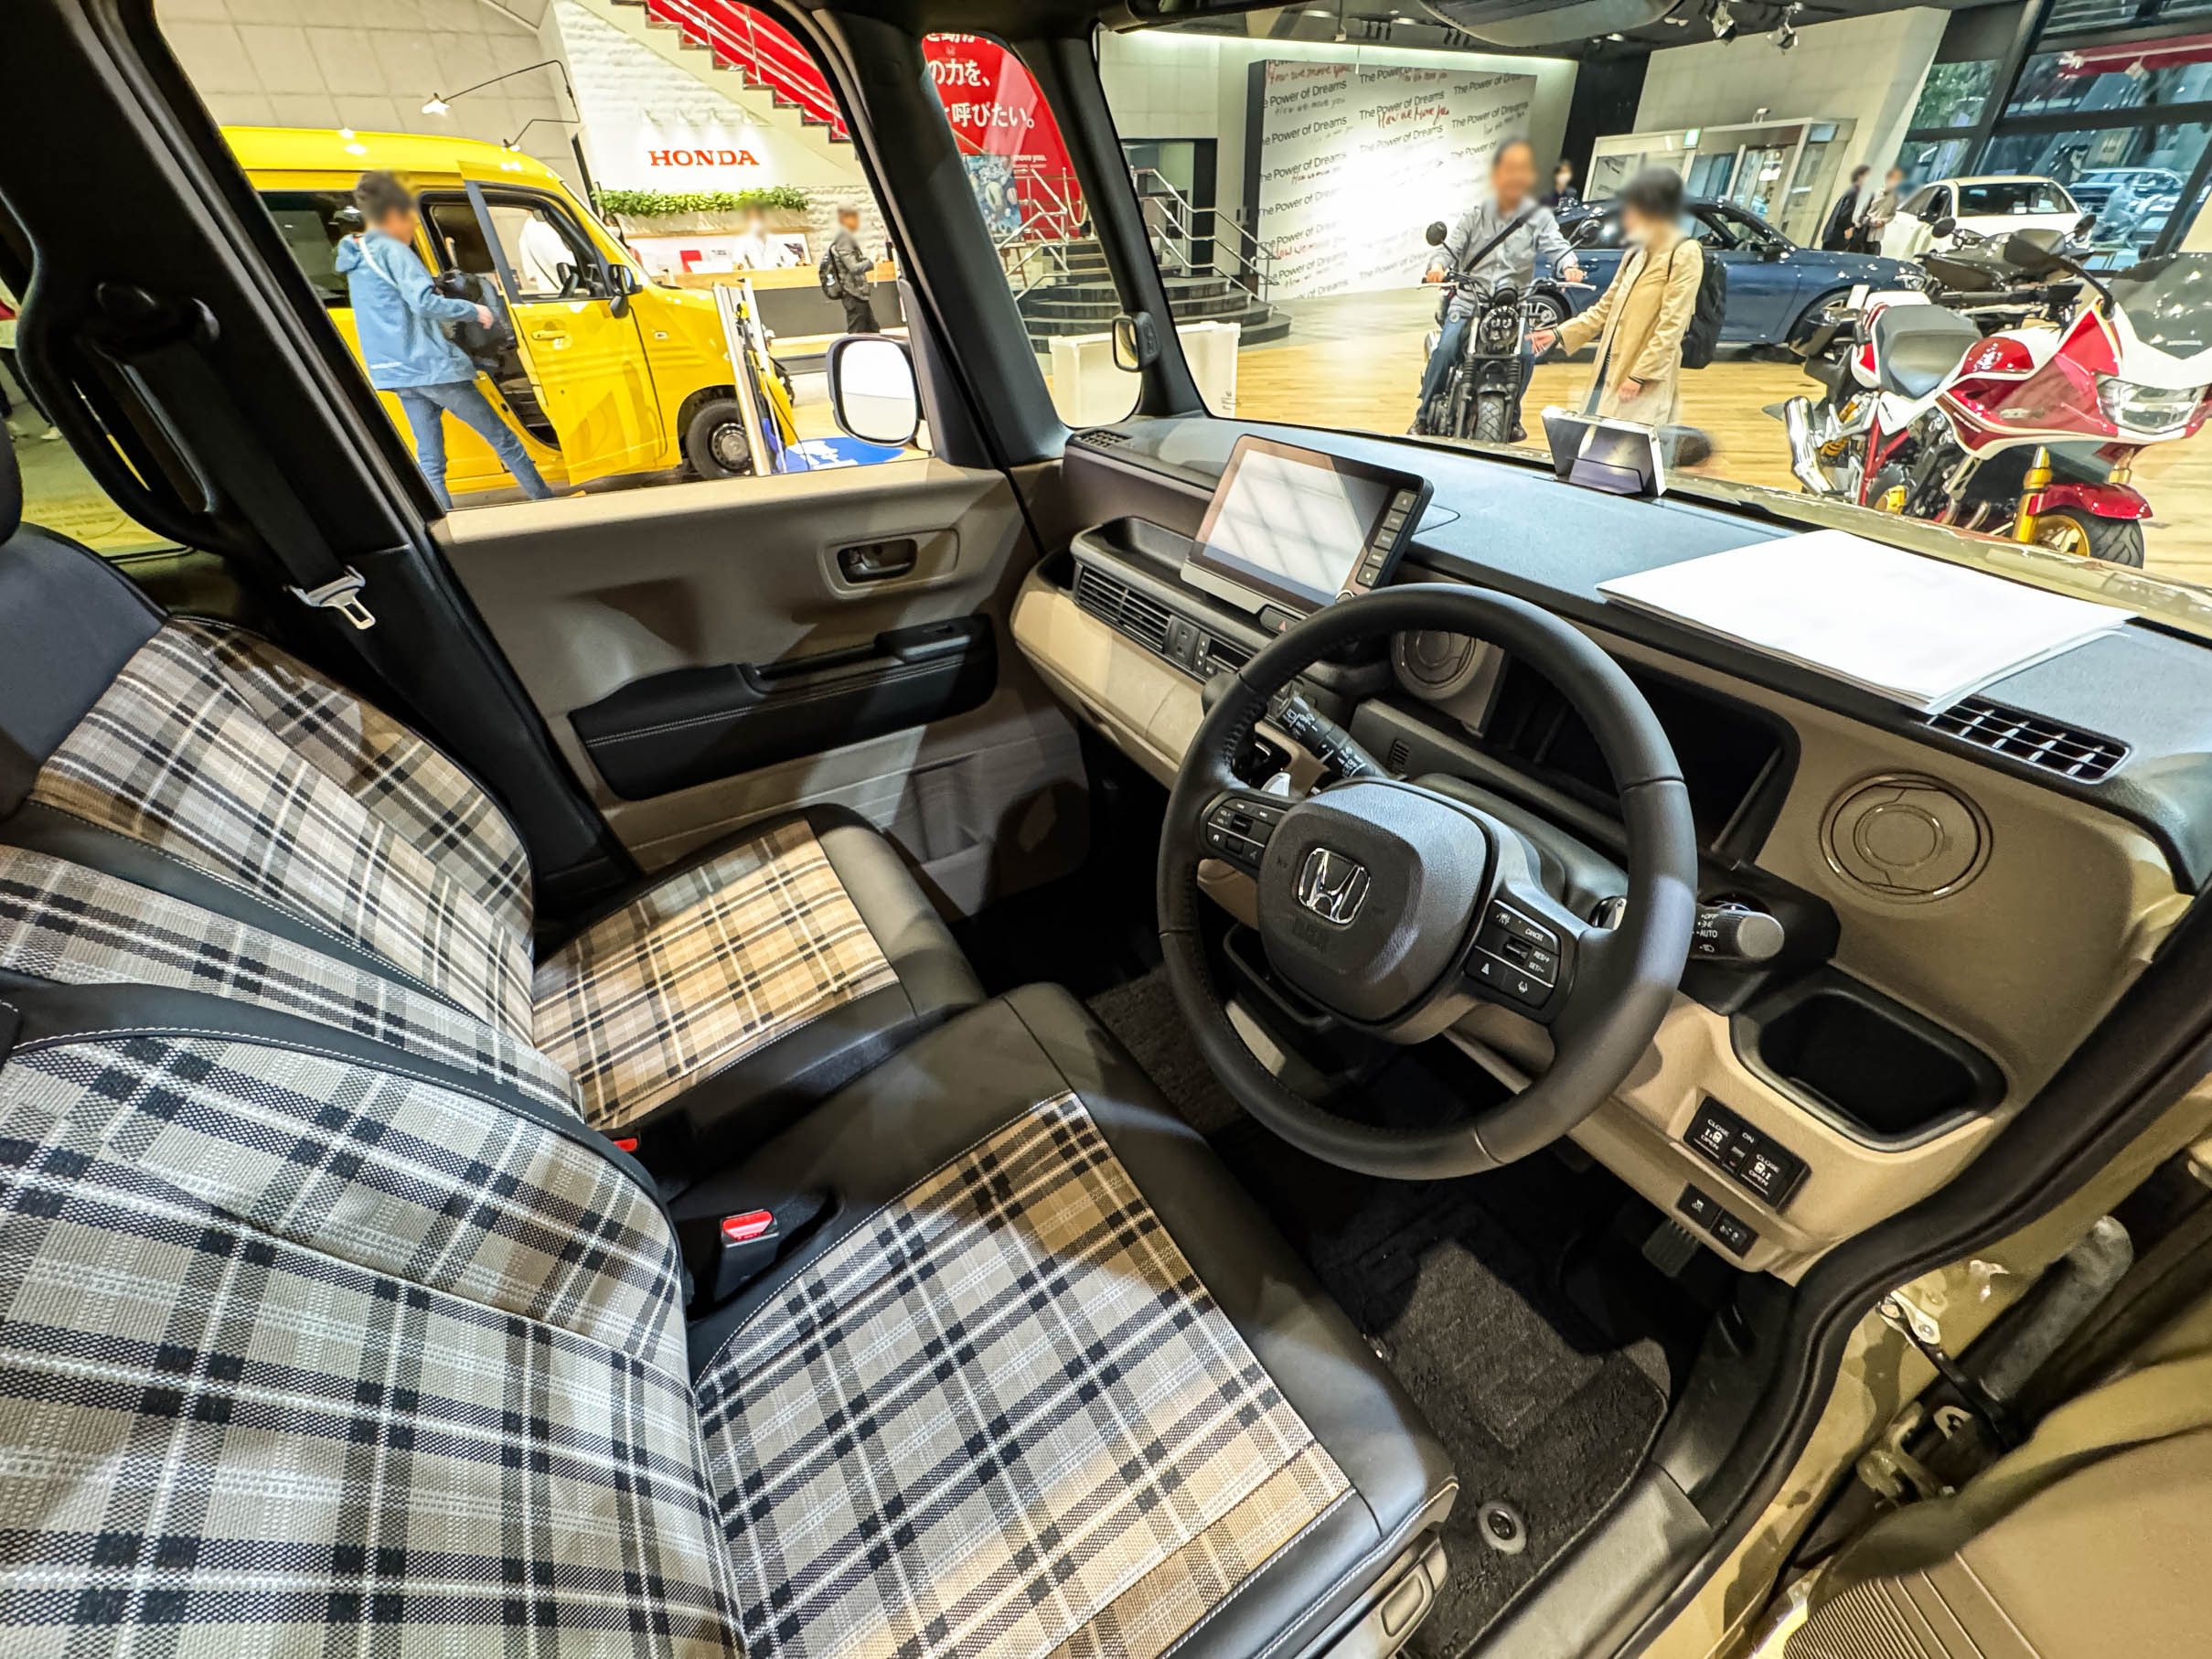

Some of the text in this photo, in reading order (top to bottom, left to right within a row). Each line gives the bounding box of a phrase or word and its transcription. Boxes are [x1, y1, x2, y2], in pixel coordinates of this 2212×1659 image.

[1359, 73, 1375, 85] The
[1453, 85, 1468, 95] The
[1469, 80, 1493, 91] Power
[1493, 76, 1502, 86] of
[1270, 91, 1298, 106] Power
[1299, 87, 1309, 100] of
[1311, 80, 1347, 96] Dreams
[945, 102, 1035, 129] 呼びたい。
[1359, 91, 1445, 121] The Power of Dreams
[1451, 119, 1467, 129] The
[1467, 112, 1491, 125] Power
[1491, 107, 1501, 118] of
[1271, 128, 1301, 144] Power
[1301, 123, 1311, 136] of
[1313, 116, 1348, 133] Dreams
[1403, 132, 1413, 143] of
[1413, 124, 1445, 141] Dreams
[647, 149, 760, 166] HONDA
[1273, 164, 1302, 179] Power
[1303, 159, 1313, 171] of
[1275, 198, 1303, 214] Power
[1304, 193, 1313, 205] of
[1277, 230, 1304, 245] Power
[1304, 226, 1314, 238] of
[1278, 264, 1305, 280] Power
[1700, 929, 1718, 938] AUTO
[1707, 1118, 1730, 1138] CLOSE
[1741, 1132, 1755, 1143] ON
[1701, 1134, 1719, 1151] OPEN
[1756, 1153, 1779, 1173] CLOSE
[1748, 1170, 1769, 1186] OPEN
